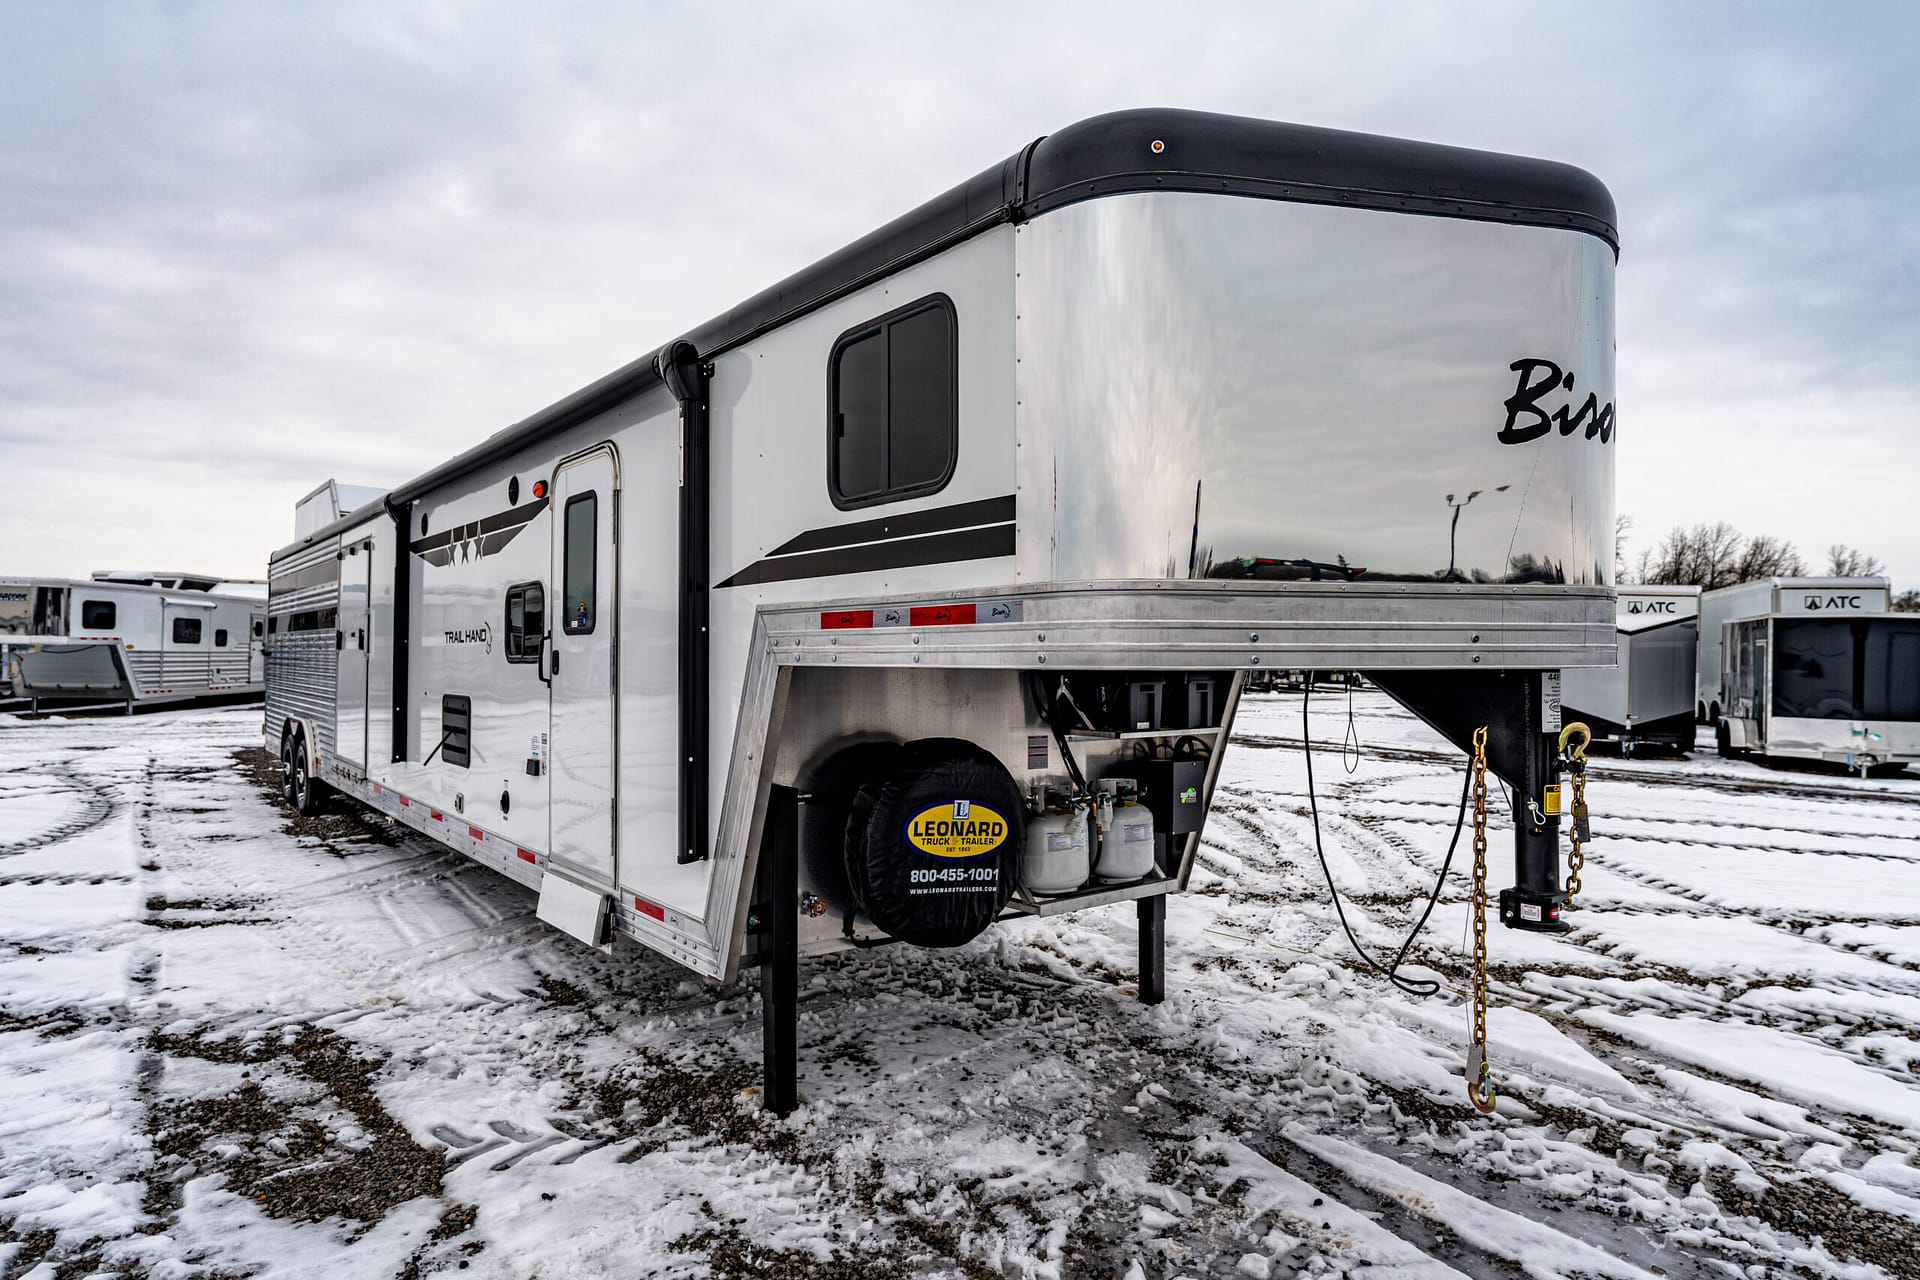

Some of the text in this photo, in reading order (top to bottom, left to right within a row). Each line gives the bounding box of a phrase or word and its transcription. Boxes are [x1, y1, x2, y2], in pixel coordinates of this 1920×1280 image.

[1497, 358, 1616, 444] Biso
[1645, 602, 1676, 613] ATC
[1825, 596, 1861, 609] ATC
[465, 629, 486, 643] HAND
[913, 821, 1003, 837] LEONARD
[910, 868, 999, 883] 800-455-1001
